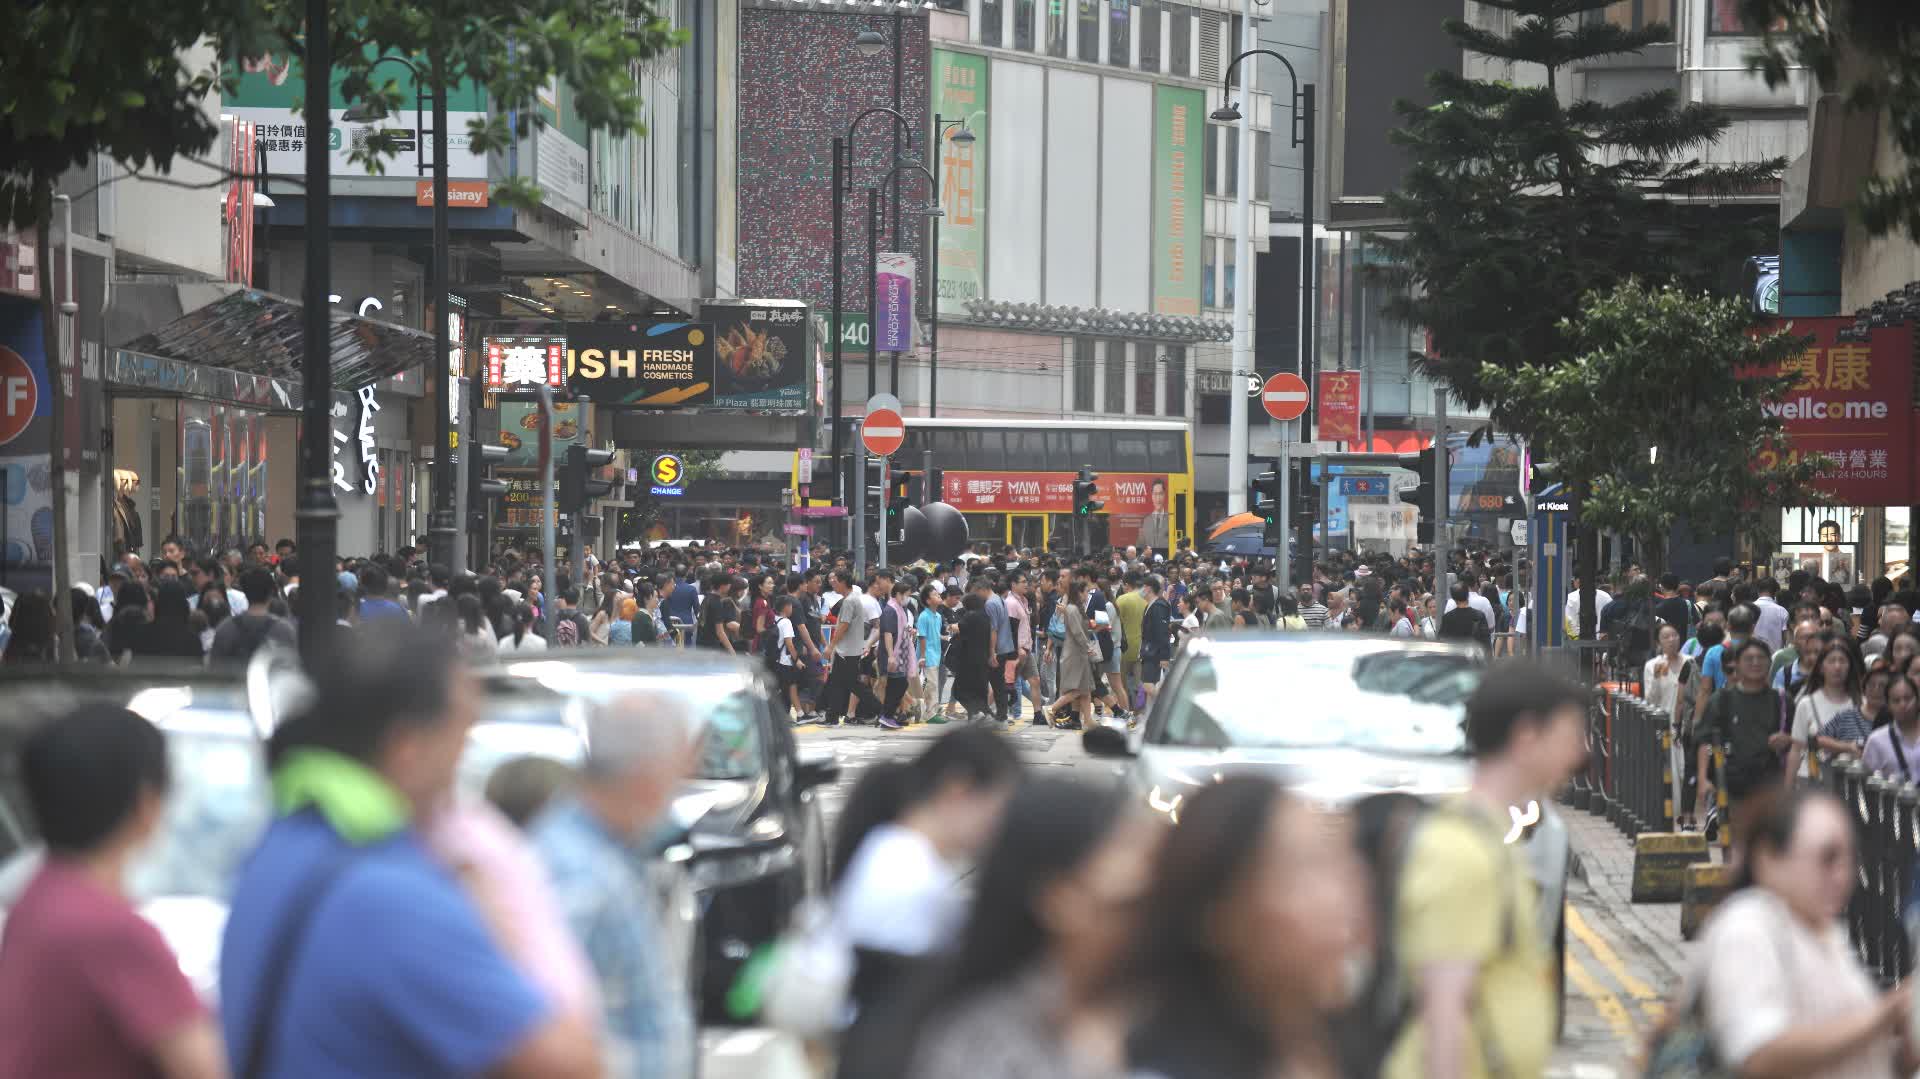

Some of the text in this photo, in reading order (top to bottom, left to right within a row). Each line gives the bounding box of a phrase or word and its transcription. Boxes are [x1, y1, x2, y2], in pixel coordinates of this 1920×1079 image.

[448, 189, 482, 203] siaray
[891, 279, 900, 347] HONG KONG
[643, 350, 694, 363] FRESH
[503, 346, 547, 385] 藥
[567, 348, 637, 379] SH
[643, 363, 693, 371] HANDMADE
[643, 372, 693, 380] COSMETICS
[0, 376, 28, 416] F
[726, 399, 748, 407] Plaza
[1760, 397, 1888, 420] wellcome
[1837, 470, 1849, 478] 24
[1851, 470, 1888, 479] HOURS
[651, 487, 682, 495] CHANGE
[1008, 481, 1041, 495] MAIYA
[1115, 482, 1147, 495] MAIYA
[1478, 496, 1503, 508] 680
[1547, 502, 1569, 511] Kiosk
